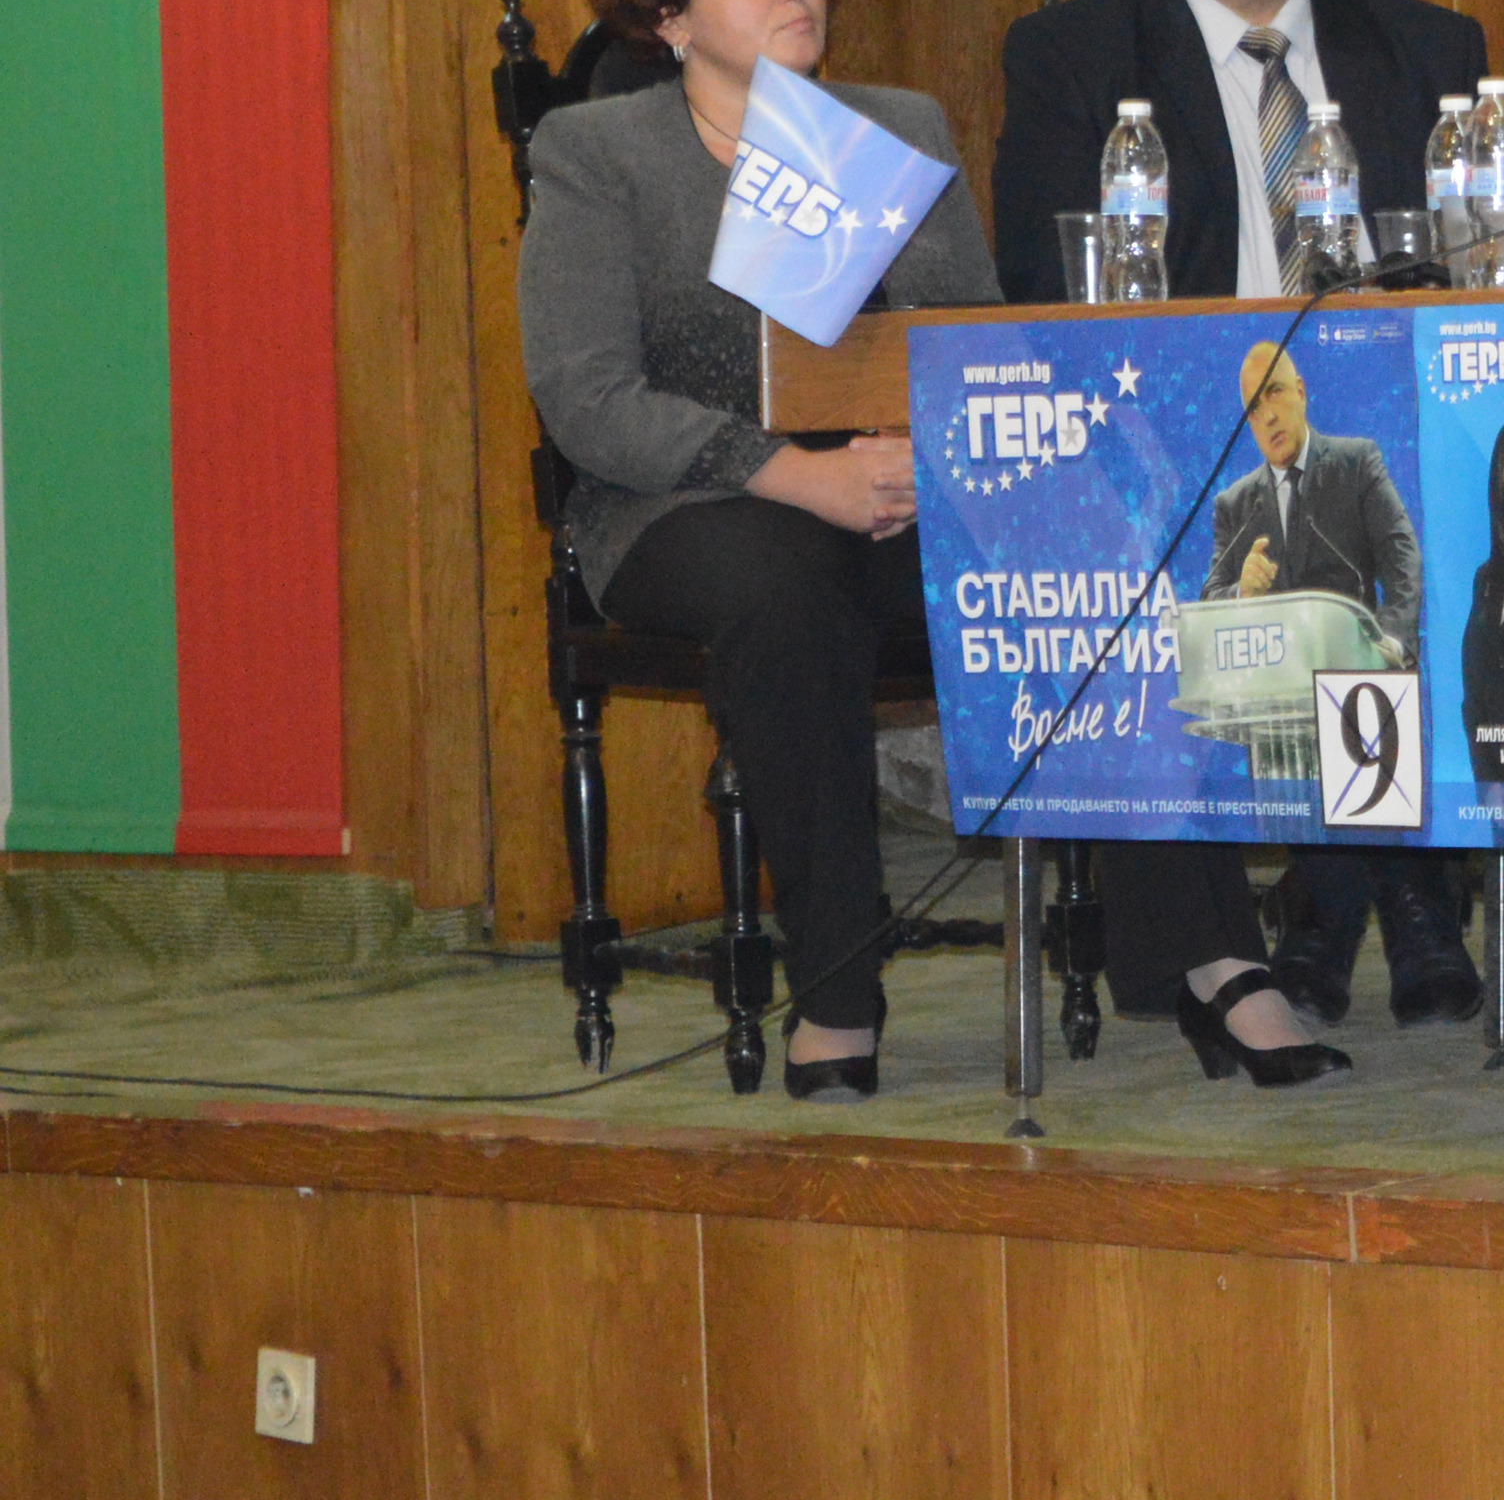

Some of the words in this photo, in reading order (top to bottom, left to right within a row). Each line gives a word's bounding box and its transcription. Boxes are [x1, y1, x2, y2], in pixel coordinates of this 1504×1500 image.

[1439, 321, 1497, 337] www.gerb.bg
[963, 362, 1050, 384] www.gerb.bg
[967, 392, 1088, 459] ГЕРБ
[956, 571, 1179, 618] СТАБИЛНА
[961, 627, 1181, 674] БЪЛГАРИЯ
[1214, 624, 1285, 670] ГЕРБ
[1008, 678, 1104, 770] Време
[1339, 682, 1400, 818] 9
[963, 797, 1032, 811] КУПУВНЕТО
[1036, 799, 1045, 811] И
[1047, 799, 1129, 814] ПРОДАВАНЕТО
[1132, 801, 1149, 813] НА
[1152, 801, 1206, 814] ГЛАСОВЕ
[1208, 802, 1215, 814] Е
[1217, 802, 1311, 816] ПРЕСТЪПЛЕНИЕ
